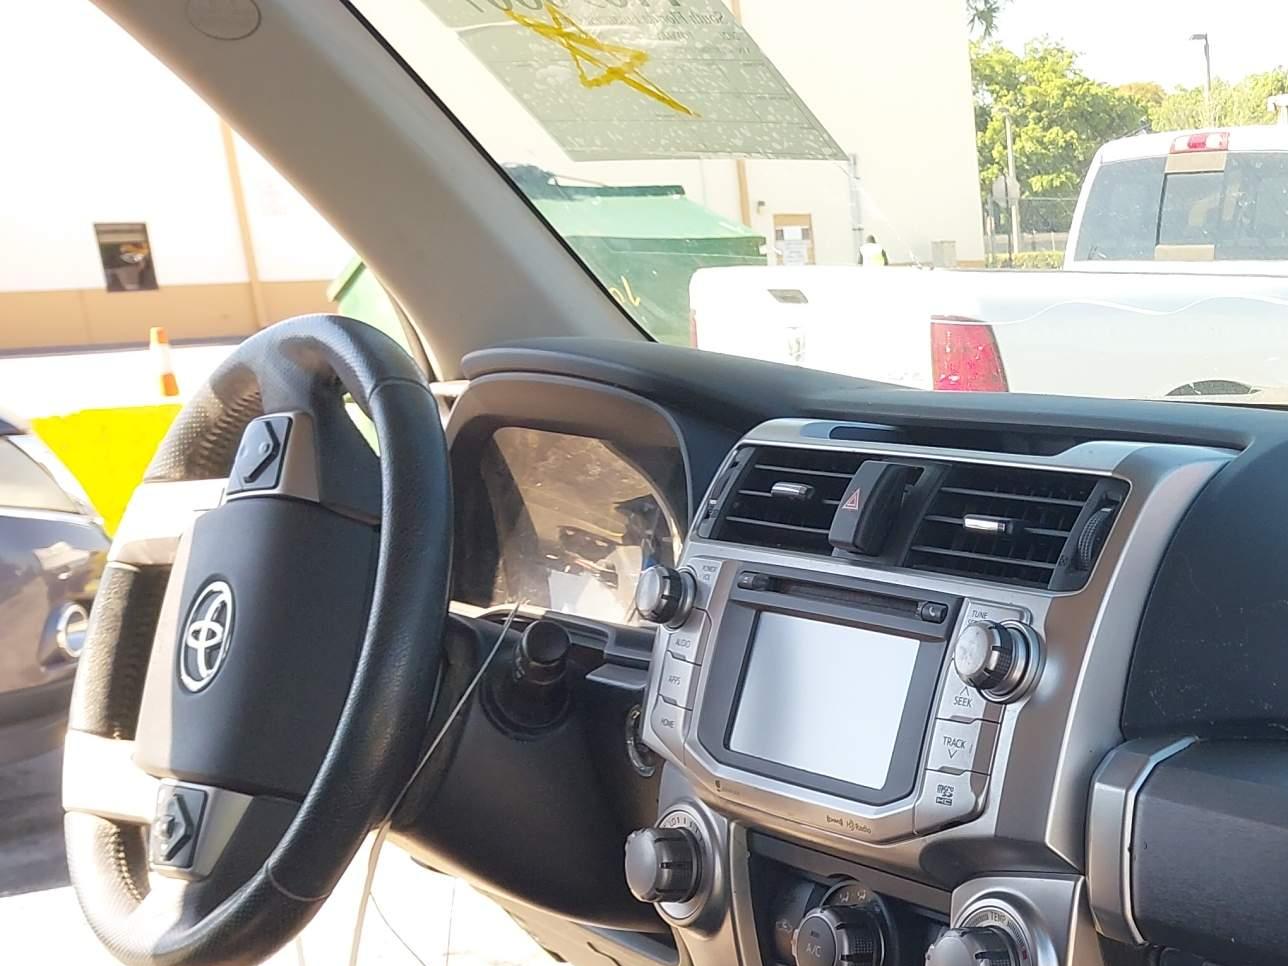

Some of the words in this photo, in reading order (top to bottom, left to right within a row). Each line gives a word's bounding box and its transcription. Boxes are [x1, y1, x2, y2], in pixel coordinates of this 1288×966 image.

[971, 609, 988, 619] TUNE
[953, 696, 972, 708] SEEK
[660, 718, 676, 729] HOME
[943, 736, 967, 750] TRACK
[806, 942, 821, 958] A/C
